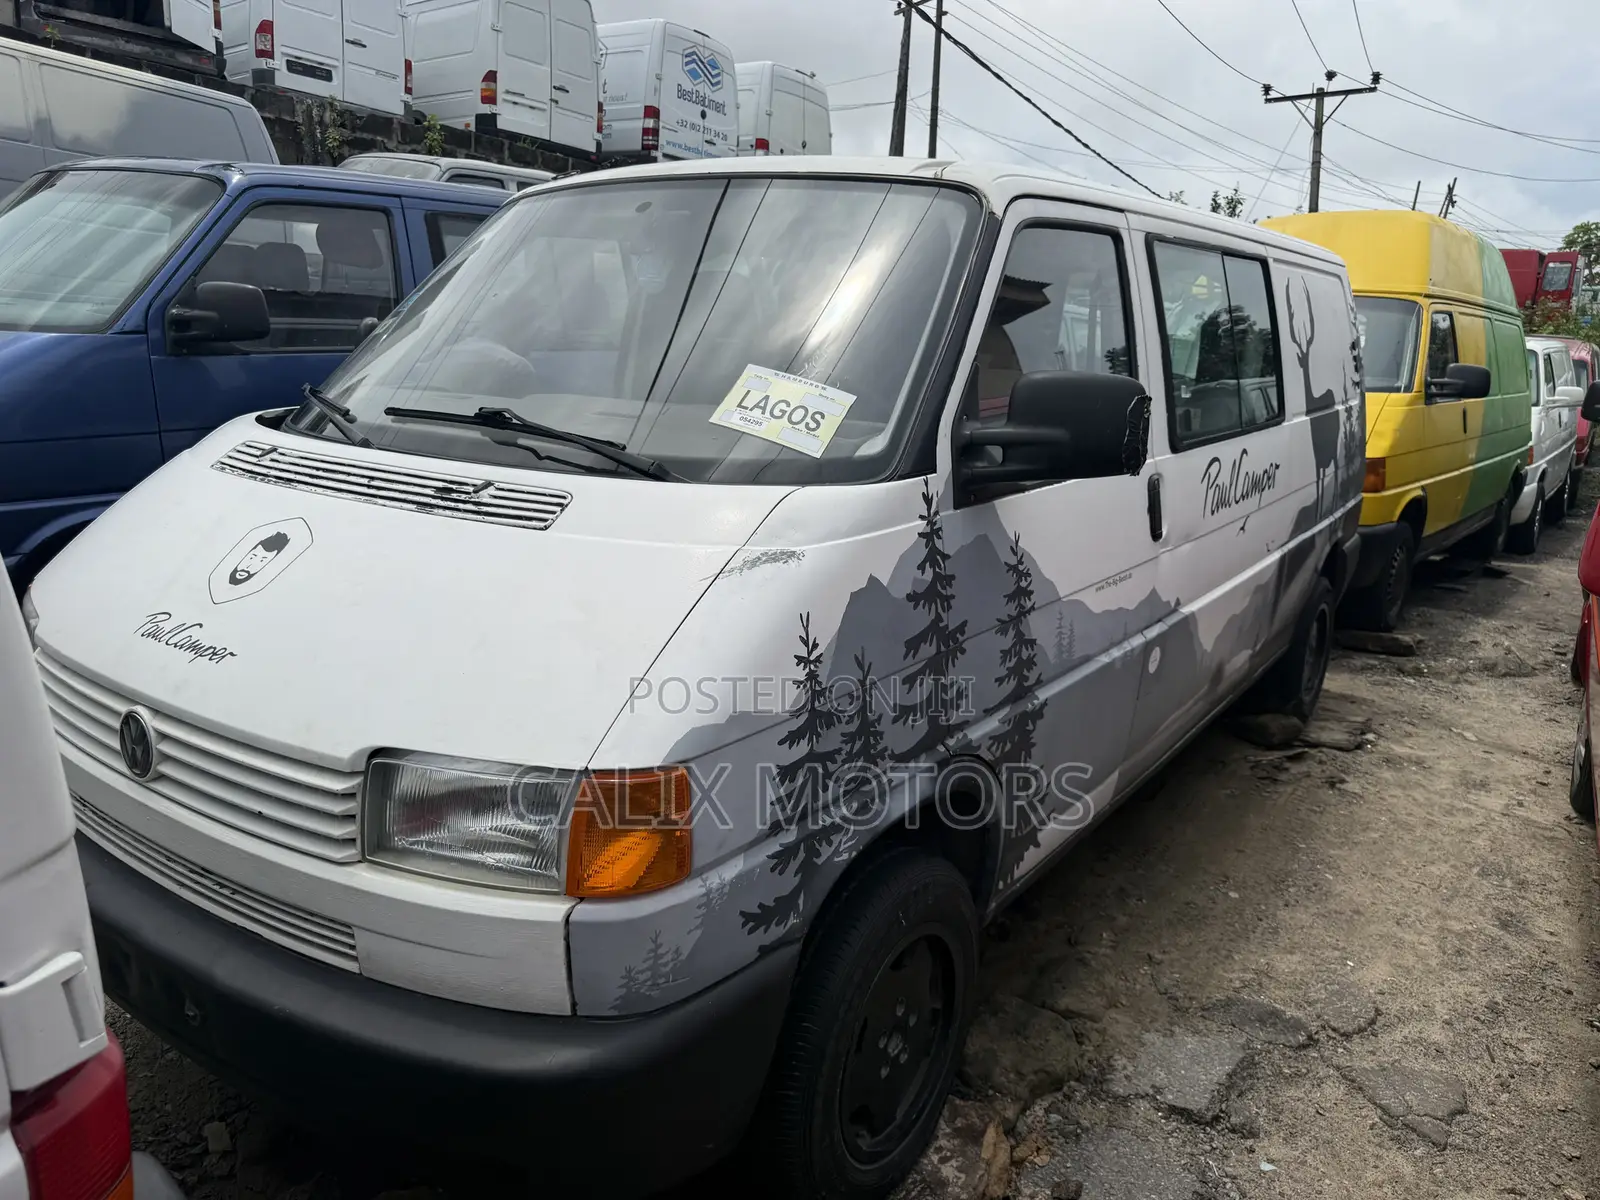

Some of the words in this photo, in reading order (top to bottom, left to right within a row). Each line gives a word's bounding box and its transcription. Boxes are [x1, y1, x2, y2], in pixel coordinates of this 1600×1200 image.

[676, 118, 689, 129] +32
[702, 126, 712, 136] 211
[713, 129, 721, 139] 34
[736, 389, 826, 433] LAGOS
[739, 415, 764, 427] 054295
